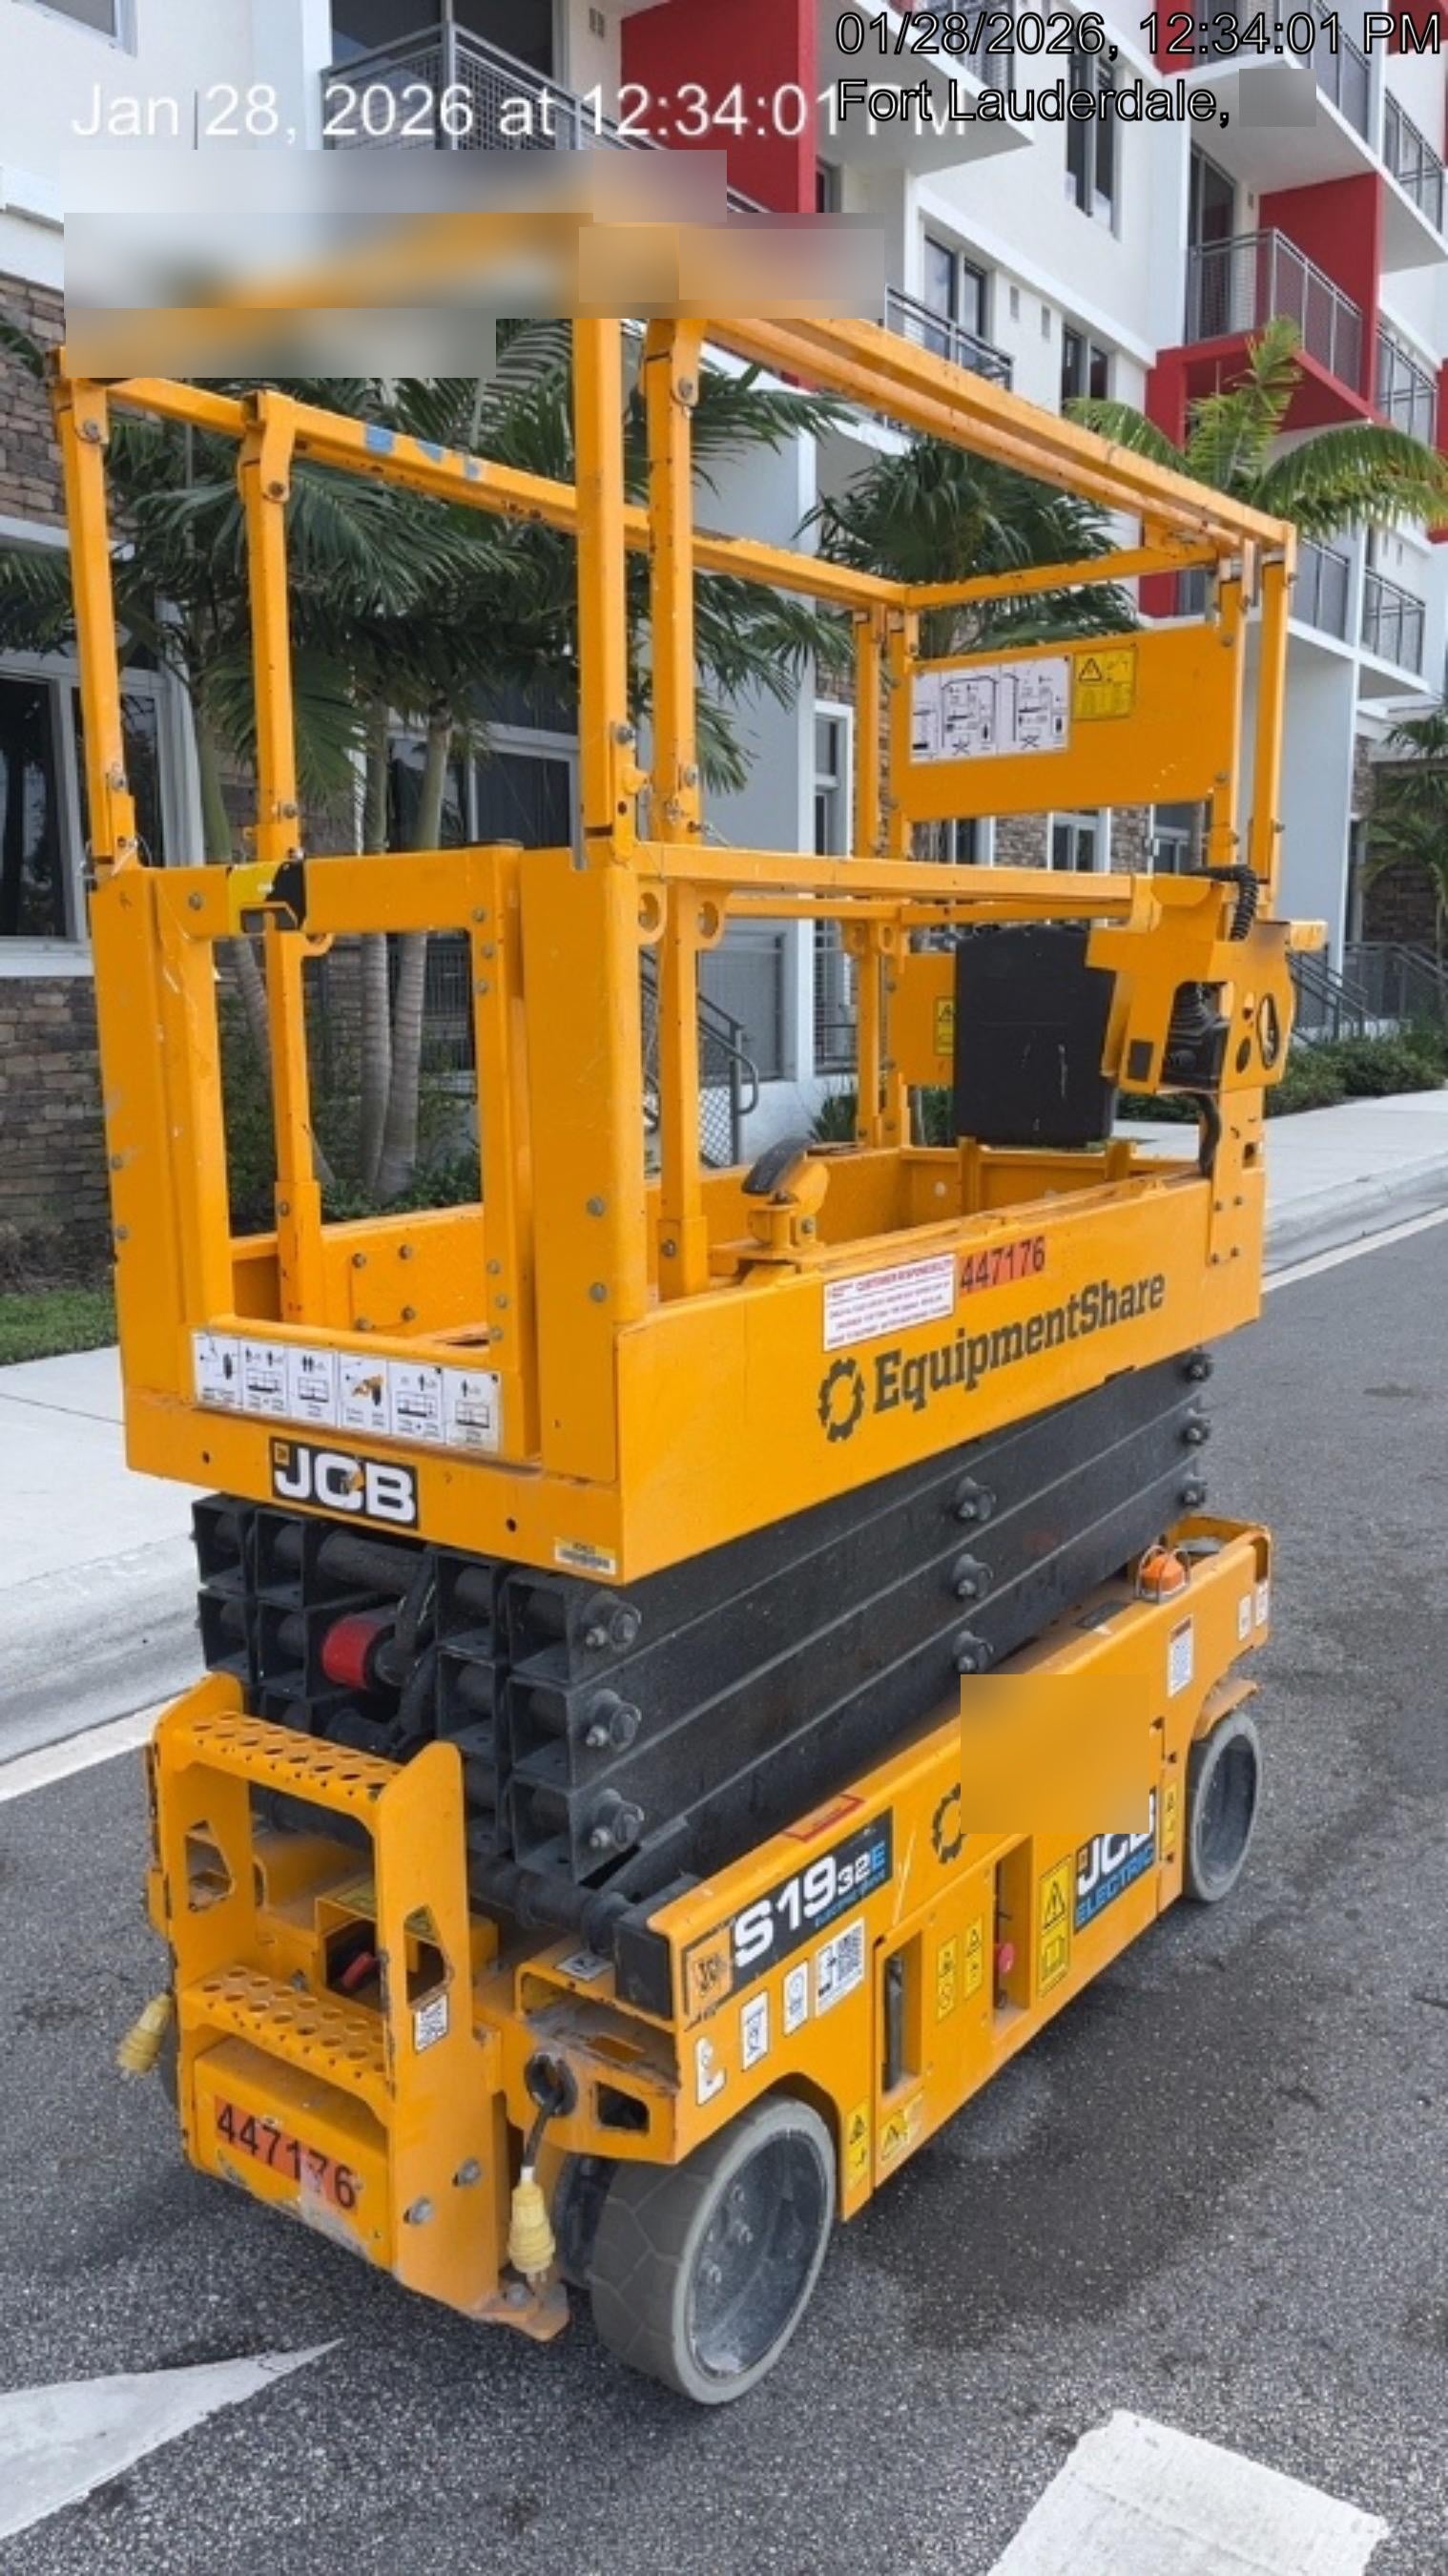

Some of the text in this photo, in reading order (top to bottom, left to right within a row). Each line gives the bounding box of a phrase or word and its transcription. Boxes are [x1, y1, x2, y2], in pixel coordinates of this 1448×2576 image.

[960, 1236, 1045, 1289] 447176
[874, 1274, 1166, 1414] EquipmentShare
[274, 1447, 415, 1523] JCB
[218, 2105, 356, 2209] 447176
